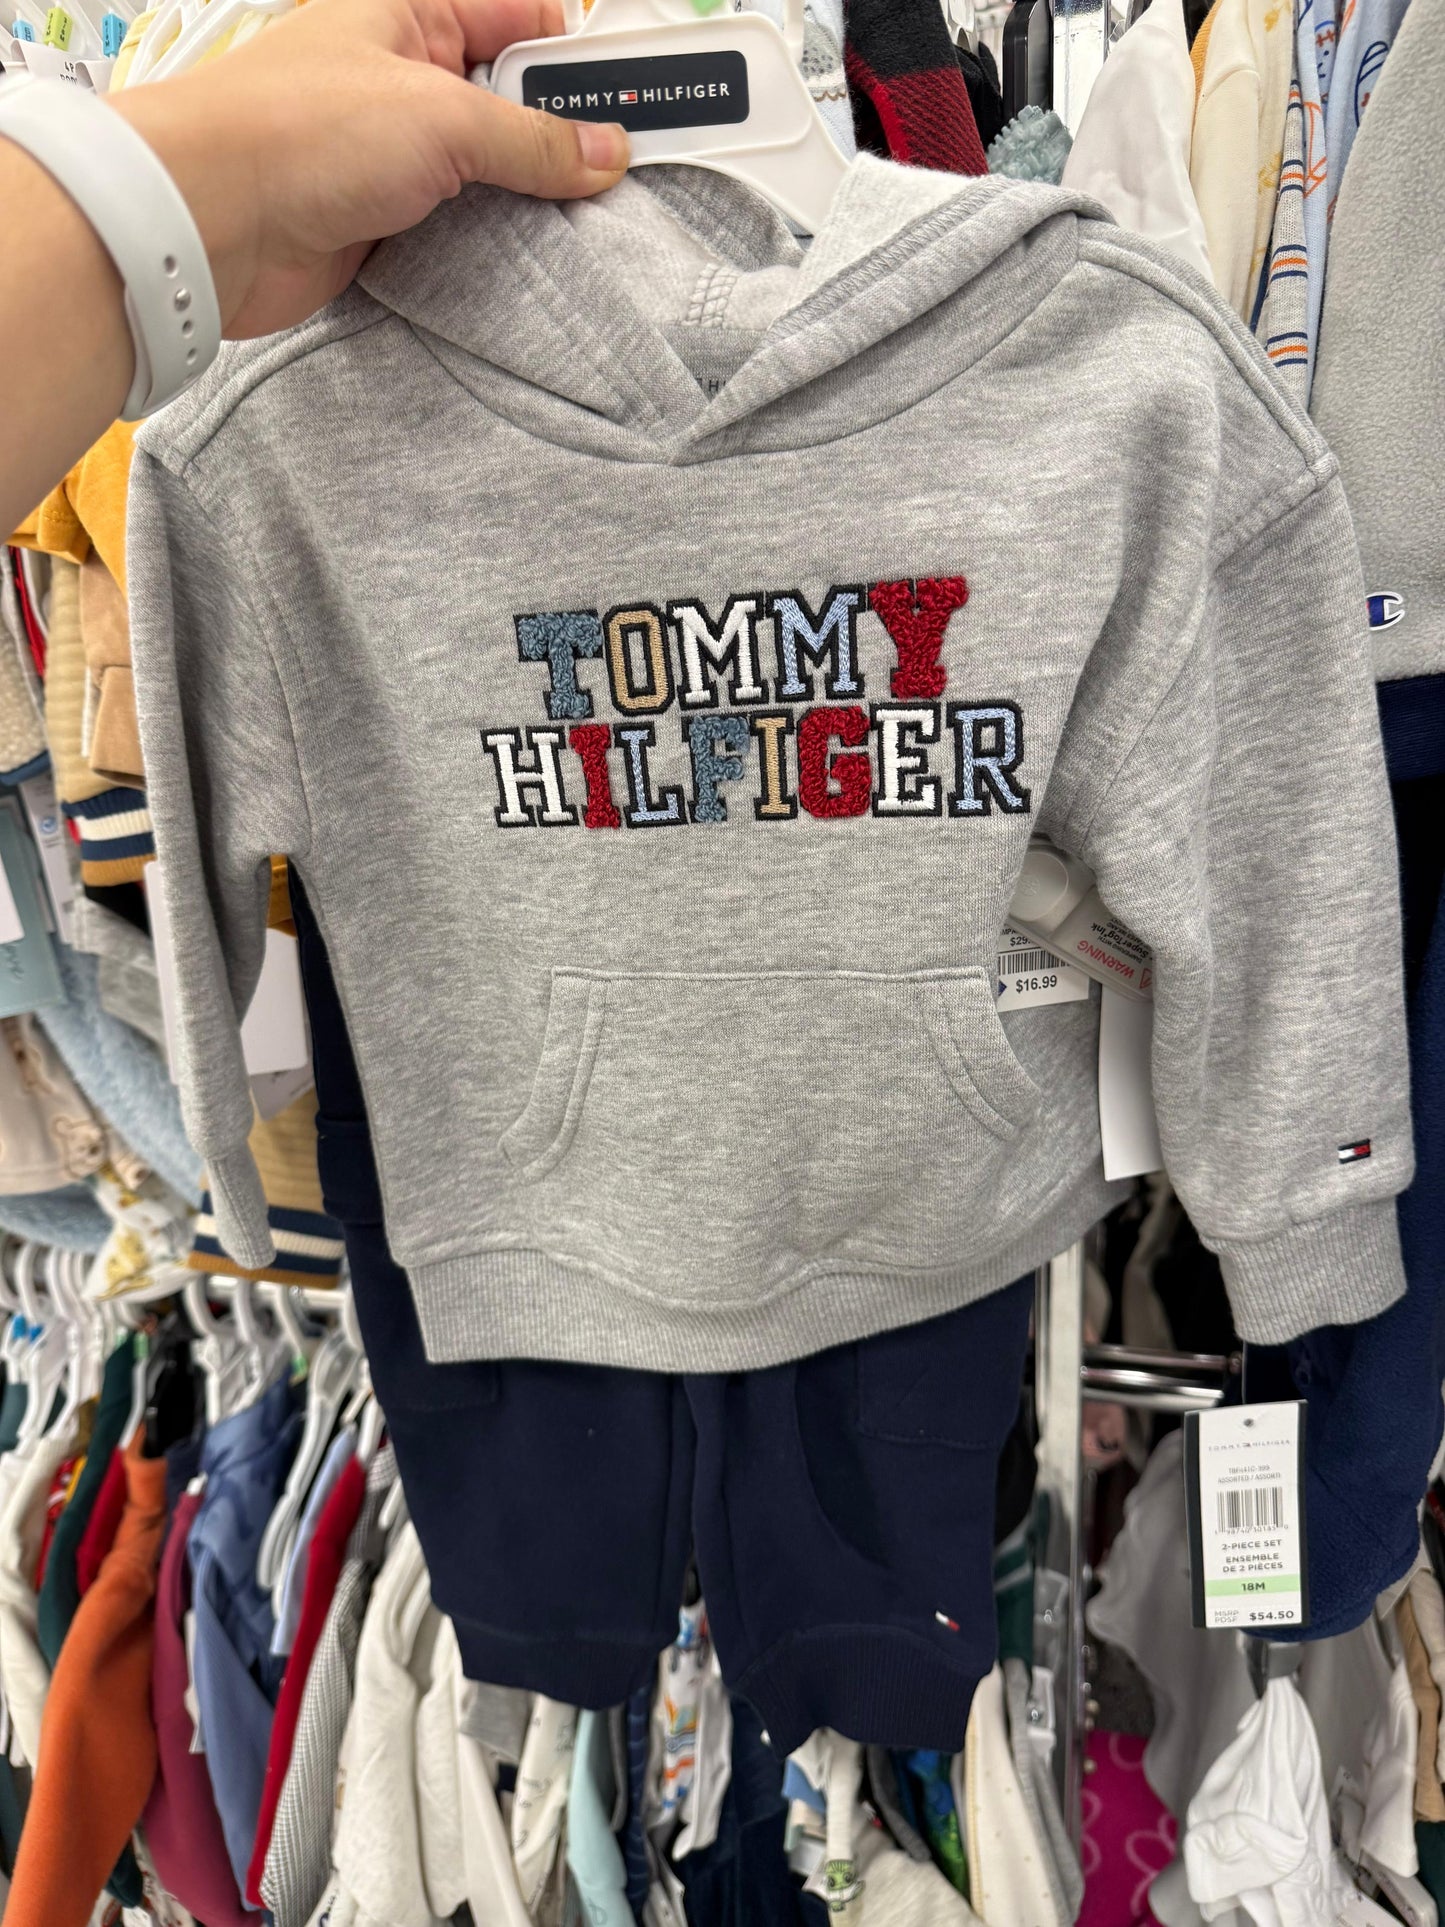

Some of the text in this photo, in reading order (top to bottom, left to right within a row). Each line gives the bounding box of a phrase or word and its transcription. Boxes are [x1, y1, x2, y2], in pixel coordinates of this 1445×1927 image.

[536, 82, 731, 111] TOMMY HILFIGER
[512, 575, 969, 720] TOMMY
[481, 701, 1032, 829] HILFIGER
[1091, 922, 1106, 935] Ink
[1009, 935, 1032, 947] $29.
[1077, 940, 1136, 979] WARNING
[1015, 974, 1058, 994] $16.99
[1221, 1539, 1282, 1551] 2-PIECE SET
[1225, 1553, 1280, 1563] ENSEMBLE
[1222, 1564, 1237, 1573] DE
[1241, 1581, 1266, 1592] 18M
[1214, 1609, 1295, 1622] MSRP $54.50
